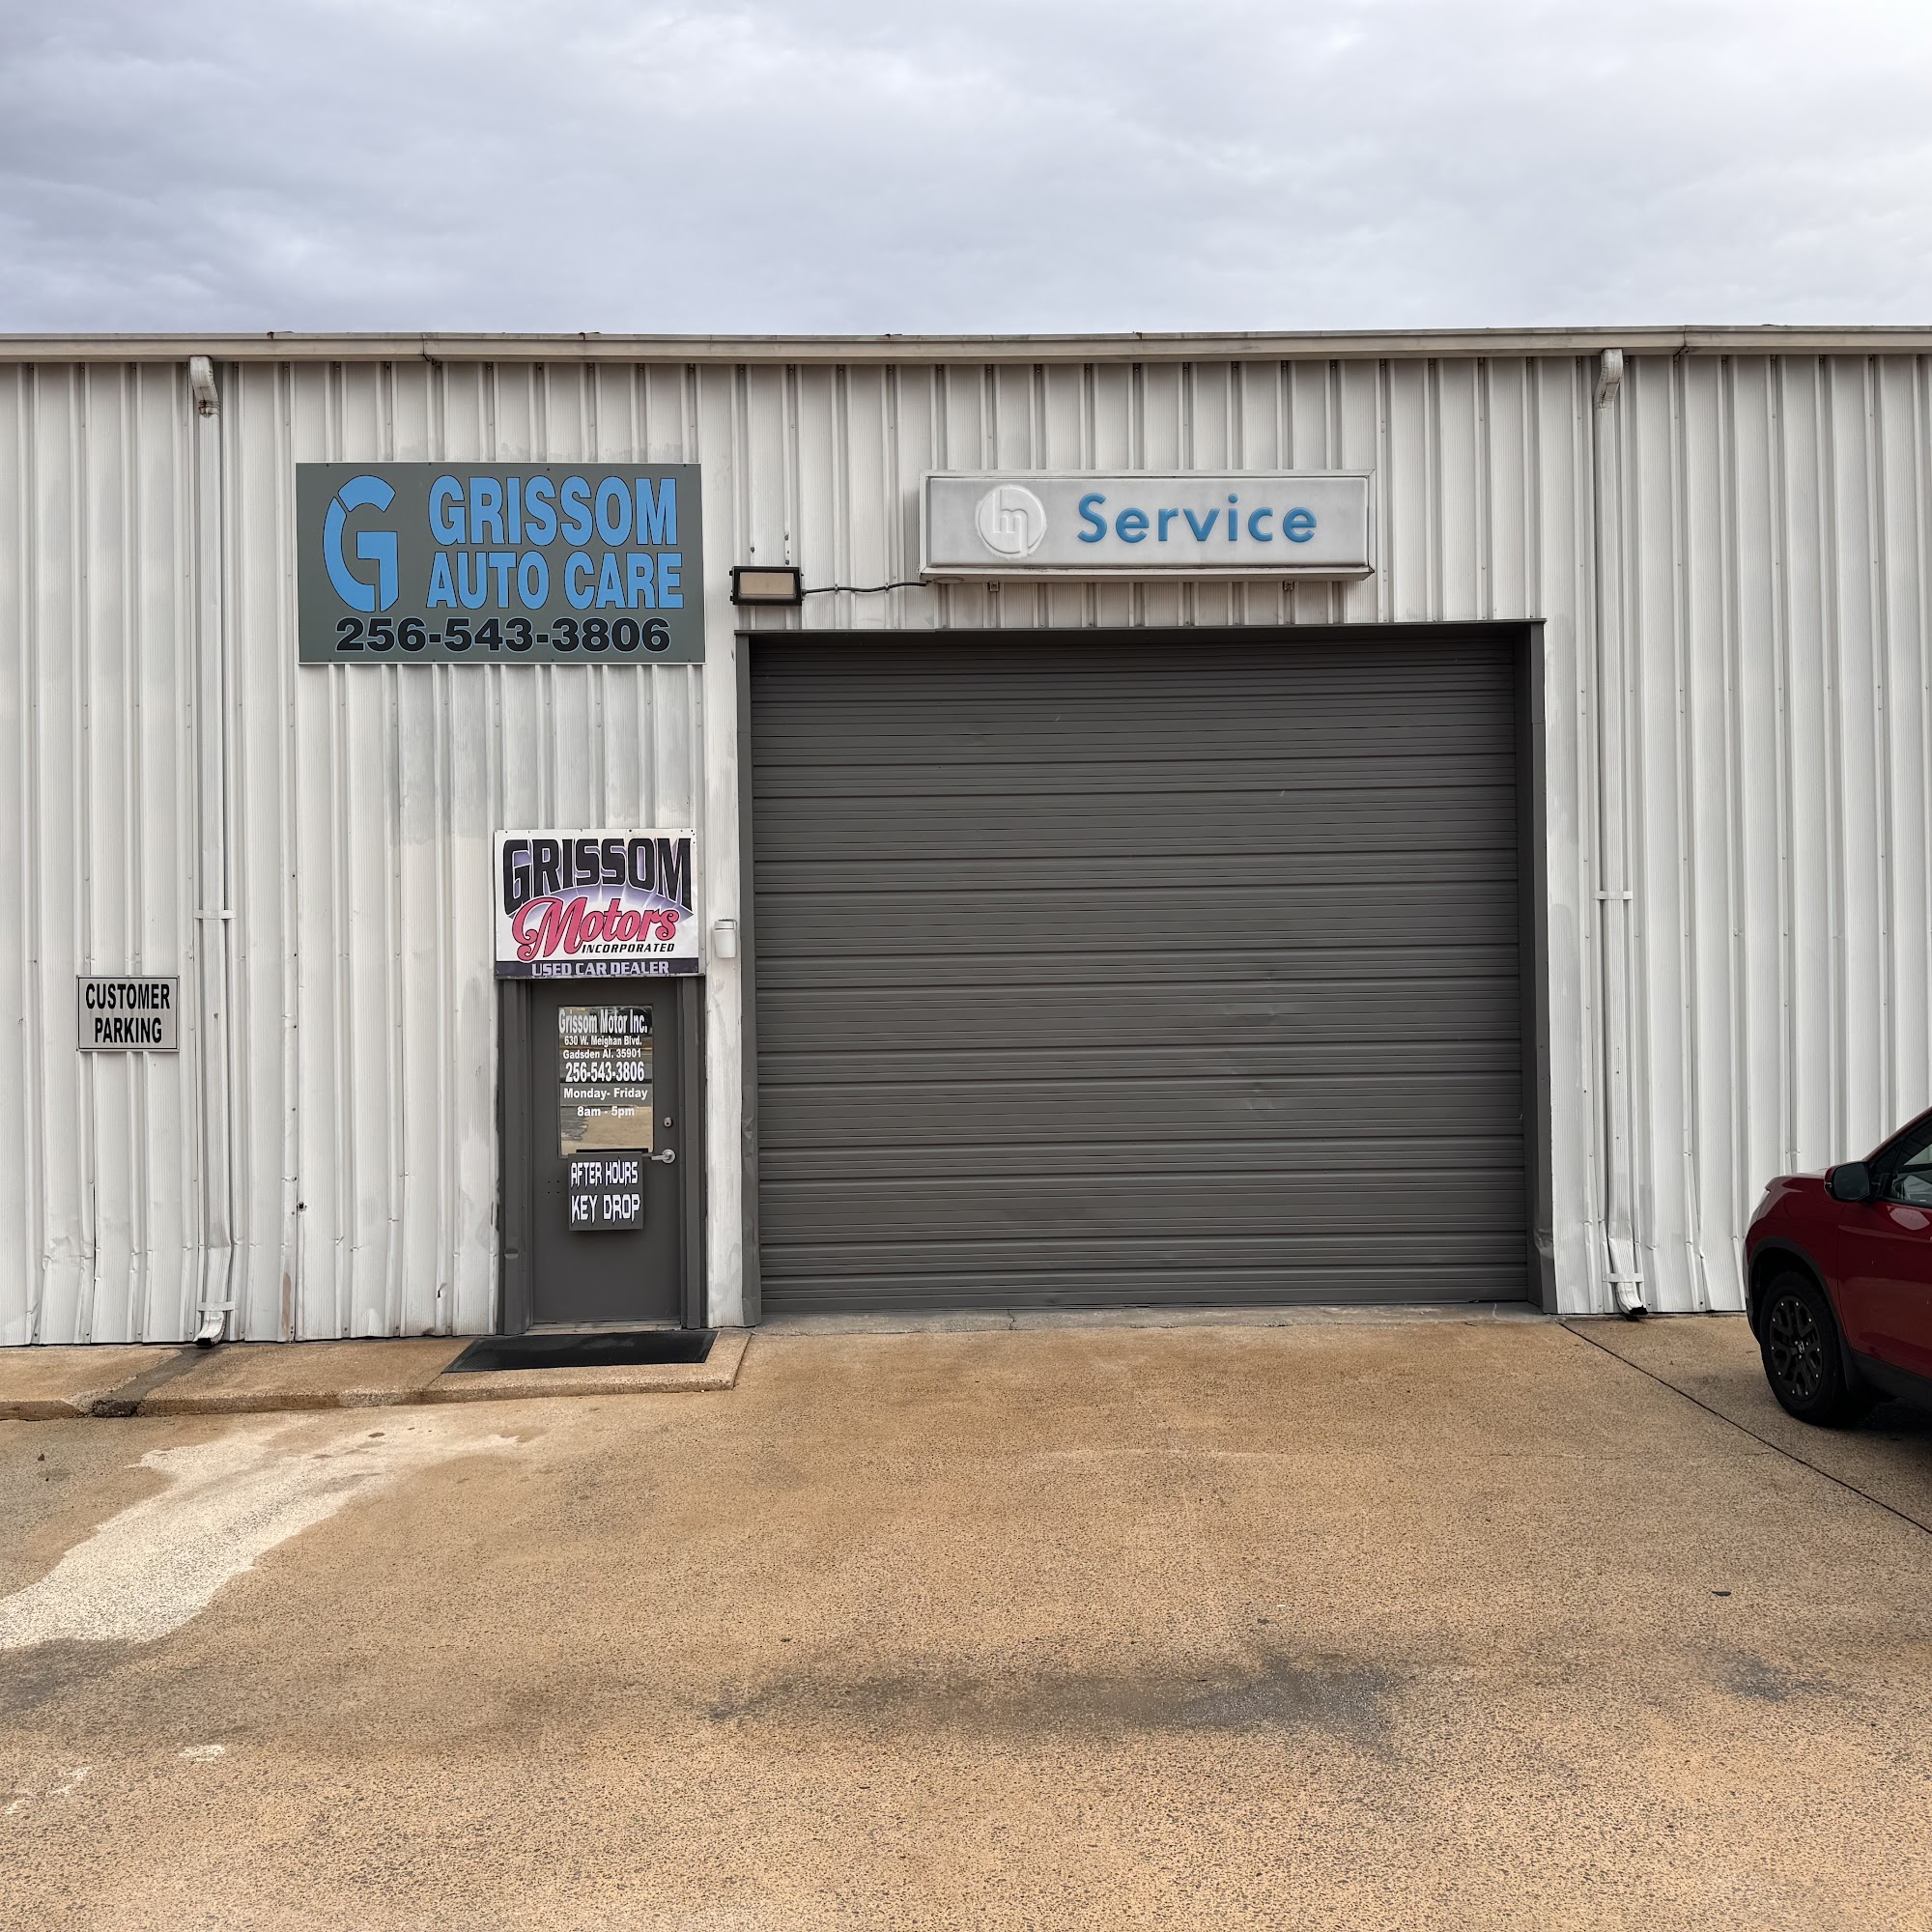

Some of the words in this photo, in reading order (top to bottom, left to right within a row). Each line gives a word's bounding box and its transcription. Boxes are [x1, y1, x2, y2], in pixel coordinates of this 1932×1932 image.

[428, 474, 677, 547] GRISSOM
[1077, 492, 1318, 544] Service
[426, 550, 550, 610] AUTO
[563, 551, 684, 611] CARE
[335, 616, 670, 653] 256-543-3806
[502, 838, 693, 916] GRISSOM
[511, 895, 680, 962] Motors
[582, 943, 675, 953] INCORPORATED
[532, 963, 573, 977] USED
[576, 962, 608, 976] CAR
[610, 961, 669, 975] DEALER
[86, 982, 170, 1009] CUSTOMER
[95, 1017, 162, 1043] PARKING
[558, 1009, 598, 1035] Grissom
[600, 1009, 628, 1034] Motor
[630, 1009, 648, 1034] Inc.
[562, 1049, 600, 1060] Gadsden
[615, 1048, 642, 1059] 35901
[564, 1036, 579, 1046] 630
[580, 1036, 589, 1046] W.
[590, 1036, 622, 1048] Meighan
[623, 1035, 642, 1046] Blvd.
[565, 1061, 645, 1083] 256-543-3806
[613, 1088, 648, 1100] Friday
[577, 1106, 601, 1117] 8am
[611, 1106, 635, 1119] 5pm
[570, 1161, 602, 1189] AFTER
[605, 1158, 639, 1188] HOURS
[571, 1194, 598, 1225] KEY
[603, 1193, 641, 1225] DROP
